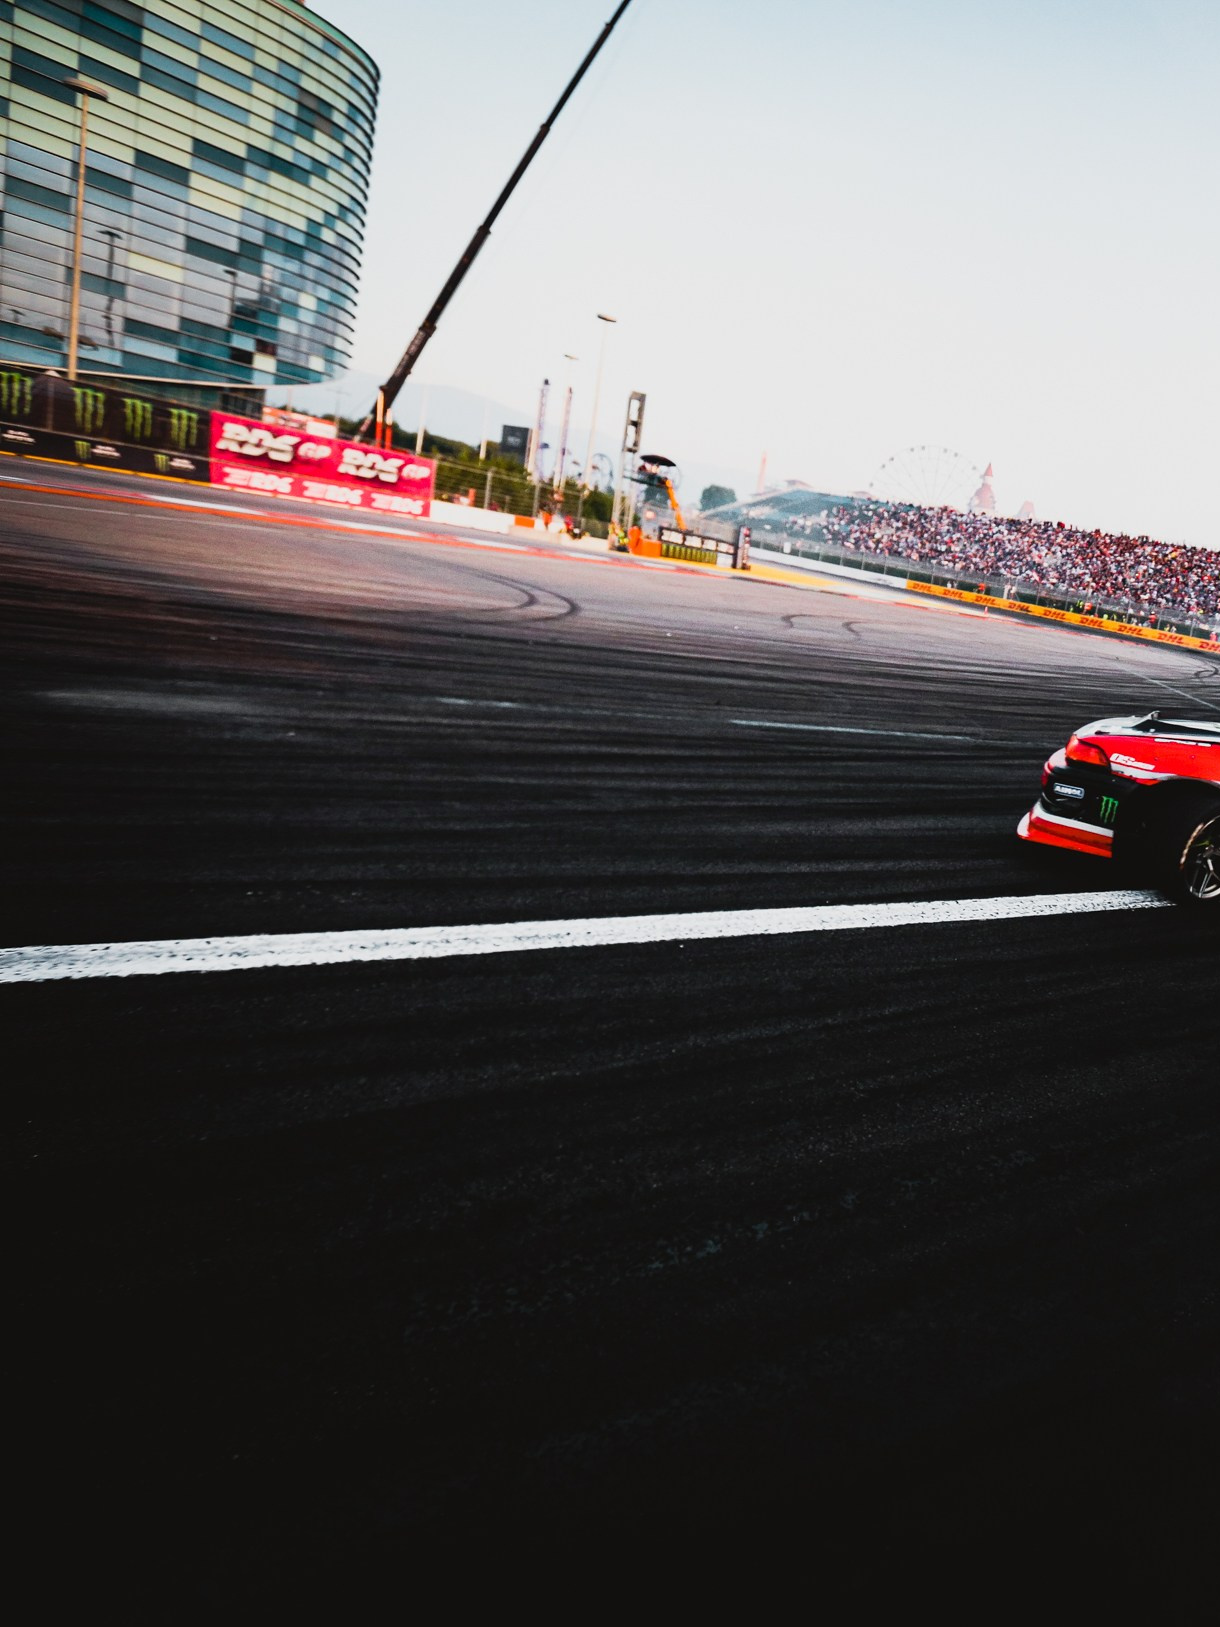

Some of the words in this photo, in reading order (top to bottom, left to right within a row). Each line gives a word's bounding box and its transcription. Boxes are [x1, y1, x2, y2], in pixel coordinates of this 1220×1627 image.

[912, 582, 933, 593] DHL
[942, 589, 964, 600] DHL
[975, 595, 997, 606] DHL
[1008, 601, 1033, 613] DHL
[1043, 609, 1067, 620] DHL
[1079, 616, 1106, 628] DHL
[1117, 624, 1144, 636] DHL
[1157, 632, 1185, 644] DHL
